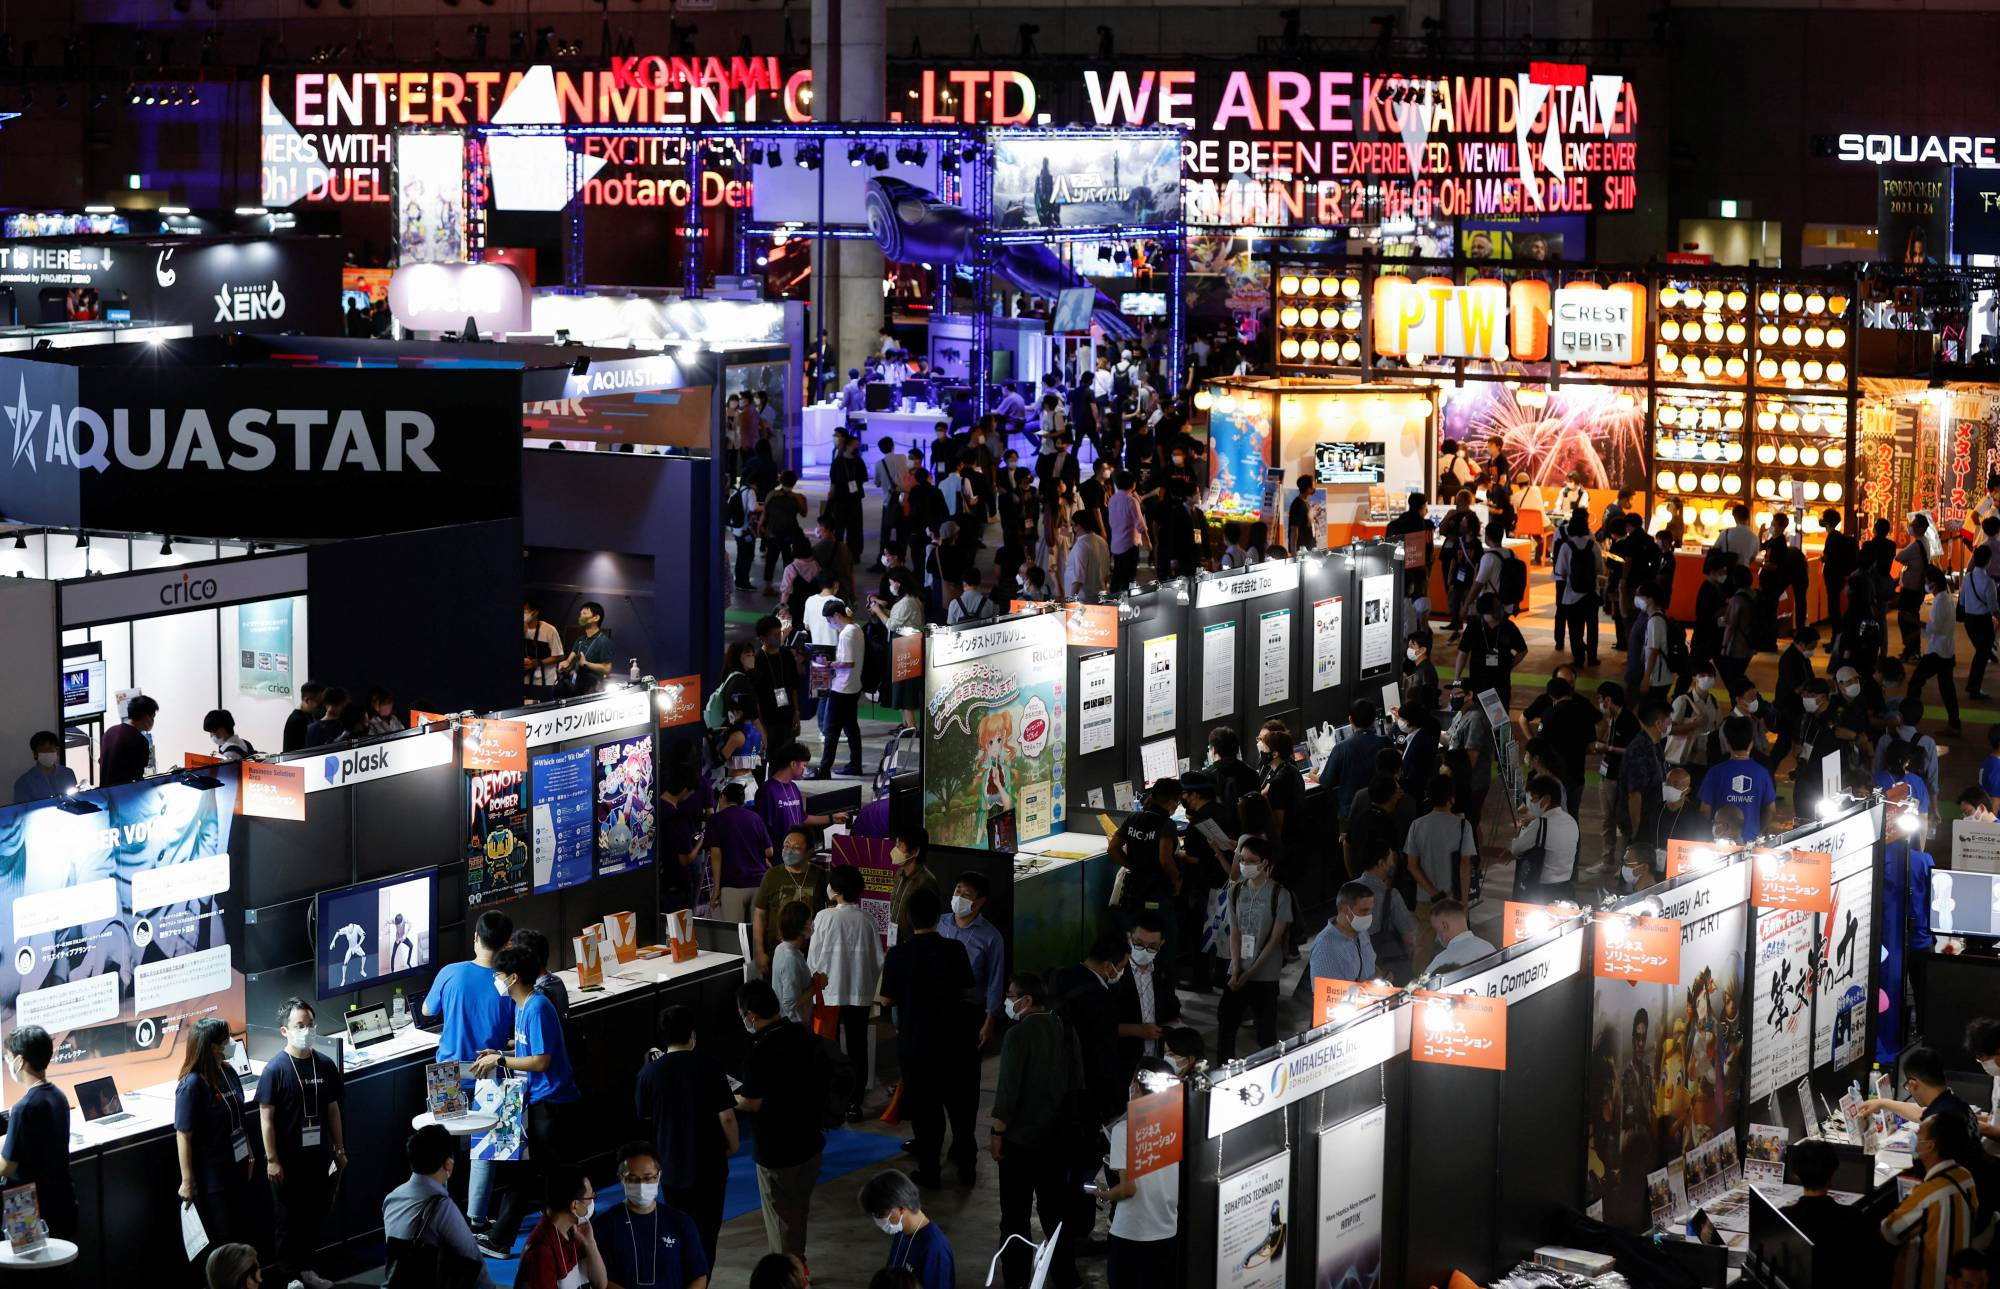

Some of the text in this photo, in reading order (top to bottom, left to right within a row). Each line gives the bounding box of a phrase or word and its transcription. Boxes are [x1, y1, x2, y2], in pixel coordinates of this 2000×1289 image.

[611, 56, 781, 90] KONAMI
[296, 71, 757, 126] ENTERTANMENT
[921, 70, 1051, 125] LTD.
[1083, 70, 1196, 130] WE
[1212, 70, 1353, 131] ARE
[322, 133, 391, 163] WITH
[1228, 140, 1321, 174] BEEN
[1331, 141, 1453, 174] EXPERIENCED.
[1457, 142, 1484, 174] WE
[1838, 134, 1997, 164] SQUARE
[305, 168, 391, 202] DUEL
[1475, 177, 1546, 214] MASTER
[1547, 176, 1593, 214] DUEL
[1883, 180, 1942, 199] FORSPOKEN
[33, 249, 98, 270] HERE...
[40, 273, 70, 284] PROJECT
[214, 280, 286, 322] XENO
[1398, 289, 1495, 356] PTW
[1560, 303, 1628, 322] CREST
[1562, 331, 1628, 352] QBIST
[592, 369, 672, 391] AQUASTAR
[1955, 399, 1980, 419] TW
[45, 403, 441, 474] AQUASTAR
[1951, 422, 1974, 507] メタバース
[160, 573, 217, 606] crico
[1231, 579, 1257, 596] 株式会社
[267, 682, 290, 695] crico
[342, 746, 389, 784] plask
[489, 793, 519, 812] BOMBER
[1761, 892, 1798, 903] コーナー
[1762, 882, 1820, 896] ソリューション
[1658, 888, 1711, 919] eeway Art
[1603, 962, 1644, 974] コーナー
[1604, 951, 1669, 966] ソリューション
[1499, 960, 1551, 995] Company
[1423, 1031, 1493, 1049] ソリューション
[1423, 1044, 1467, 1057] コーナー
[1288, 1046, 1344, 1078] MIRAISENS,
[1135, 1122, 1161, 1142] ビジネス
[1135, 1132, 1177, 1155] ソリューション
[1134, 1153, 1161, 1169] コーナー
[1252, 1177, 1284, 1202] TECHNOLOGY
